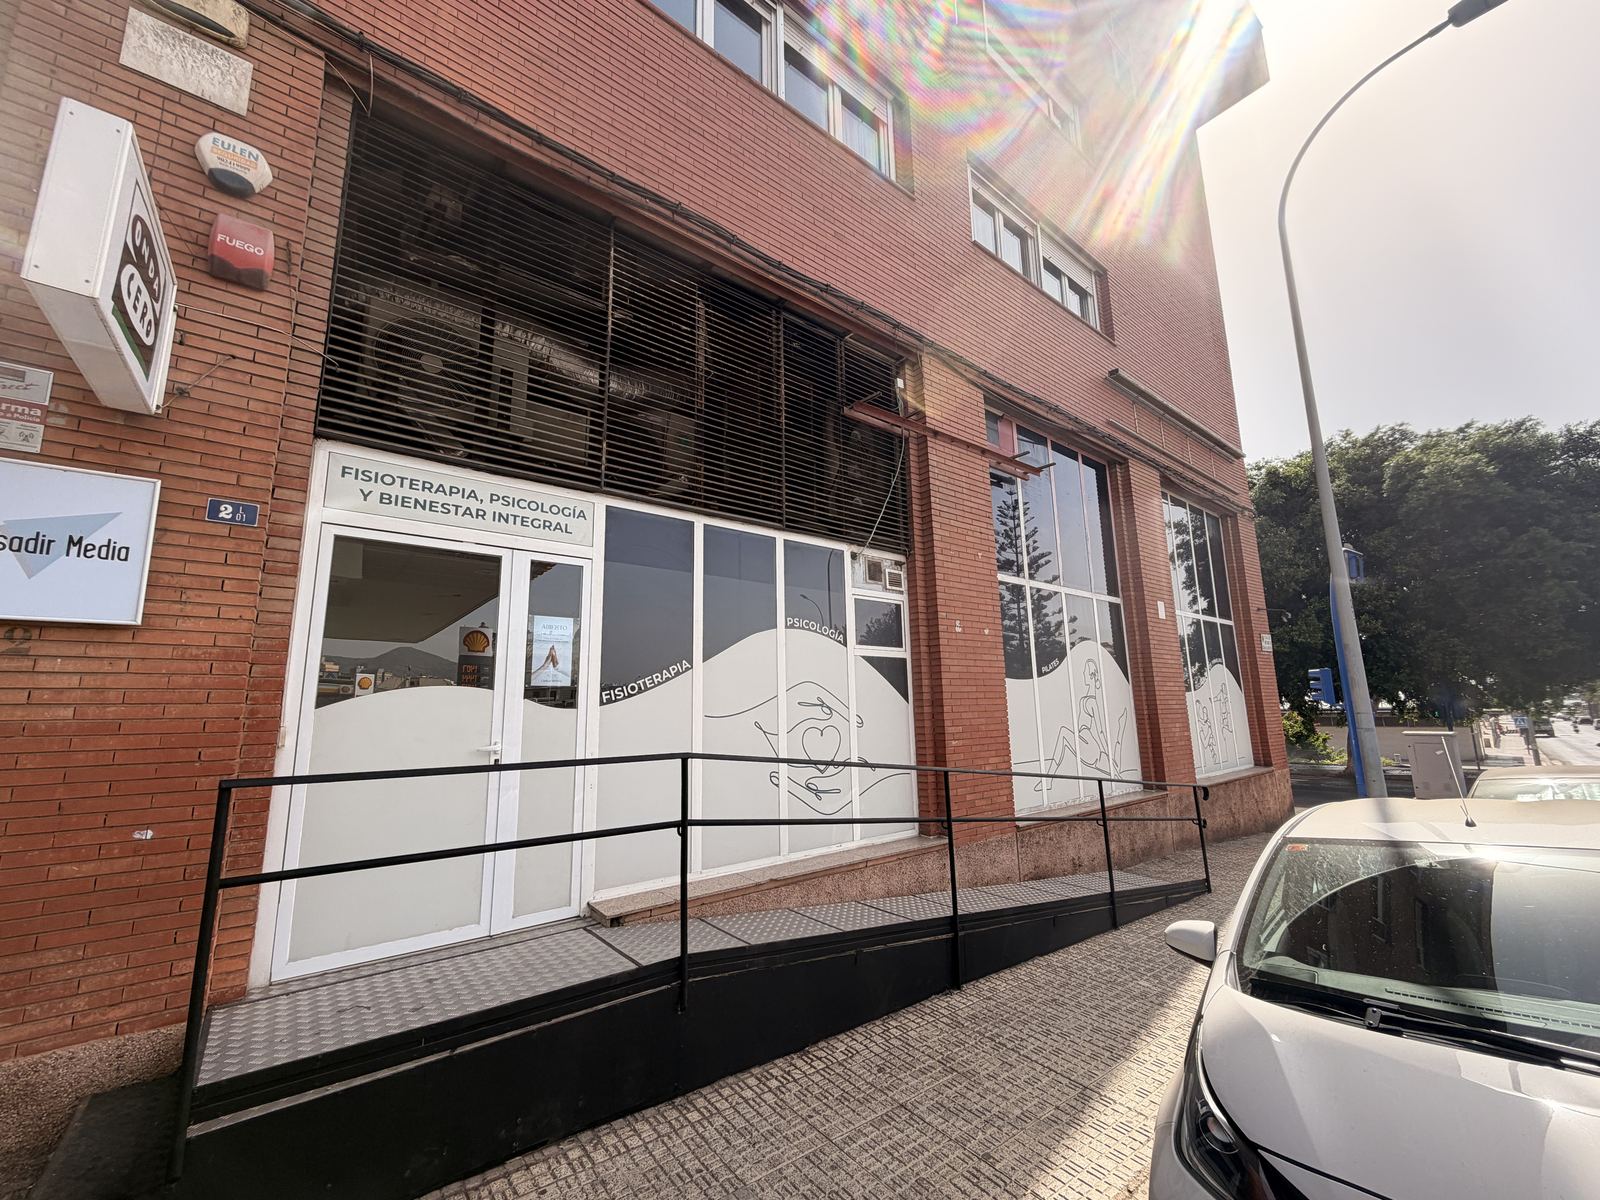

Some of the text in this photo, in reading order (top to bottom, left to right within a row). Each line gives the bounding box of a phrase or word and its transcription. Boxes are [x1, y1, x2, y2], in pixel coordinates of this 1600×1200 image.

[212, 137, 260, 162] EULEN
[135, 220, 159, 297] ONDA
[217, 233, 265, 256] FUEGO
[127, 272, 152, 339] CERO
[1, 402, 42, 417] rma
[340, 465, 587, 521] FISIOTERAPIA, PSICOLOGÍA
[218, 504, 233, 519] 2
[359, 488, 573, 535] Y BIENESTAR INTEGRAL
[0, 531, 130, 562] sadir Media
[786, 616, 845, 644] PSICOLOGÍA
[1041, 657, 1060, 674] PILATES
[601, 659, 692, 704] FISIOTERAPIA
